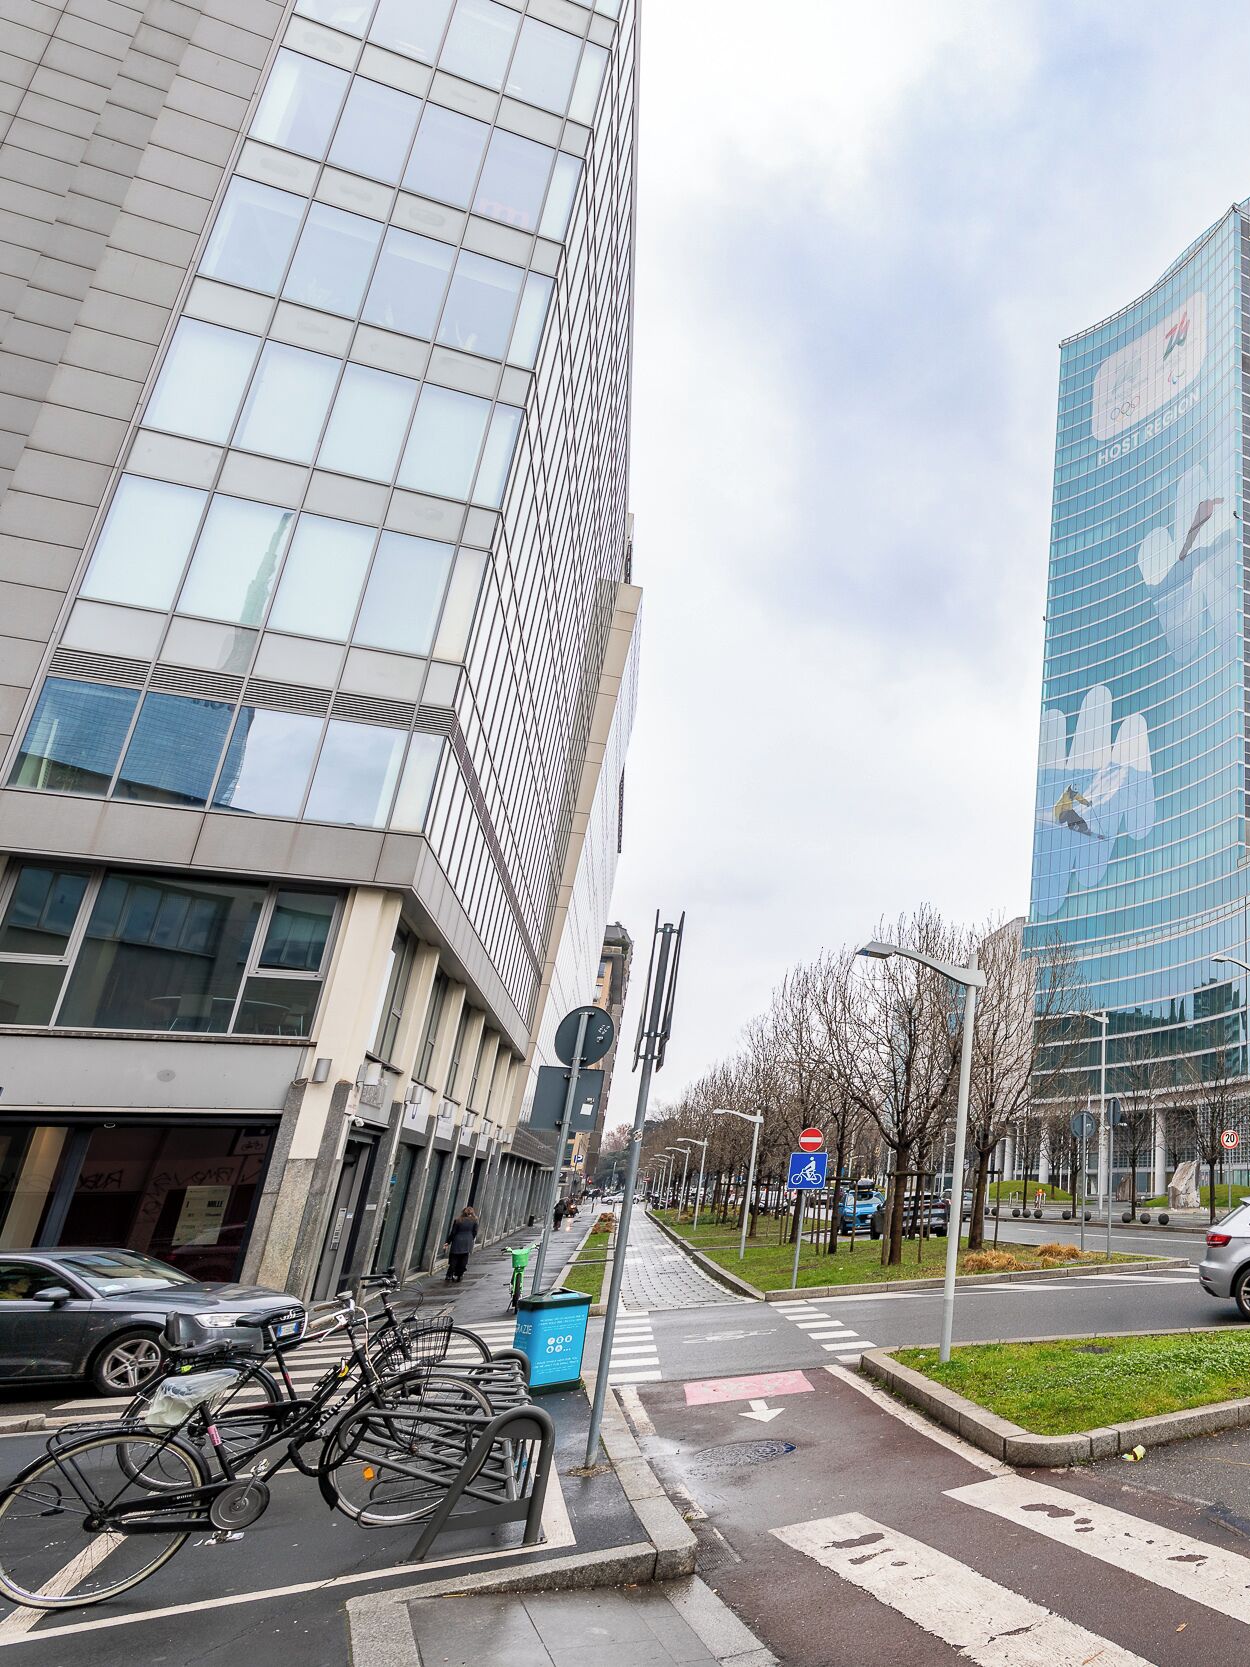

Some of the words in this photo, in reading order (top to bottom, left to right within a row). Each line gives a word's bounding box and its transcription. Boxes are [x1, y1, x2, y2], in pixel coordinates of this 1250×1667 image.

[1098, 431, 1140, 466] HOST
[1145, 388, 1200, 440] REGION
[1225, 1133, 1235, 1143] 20
